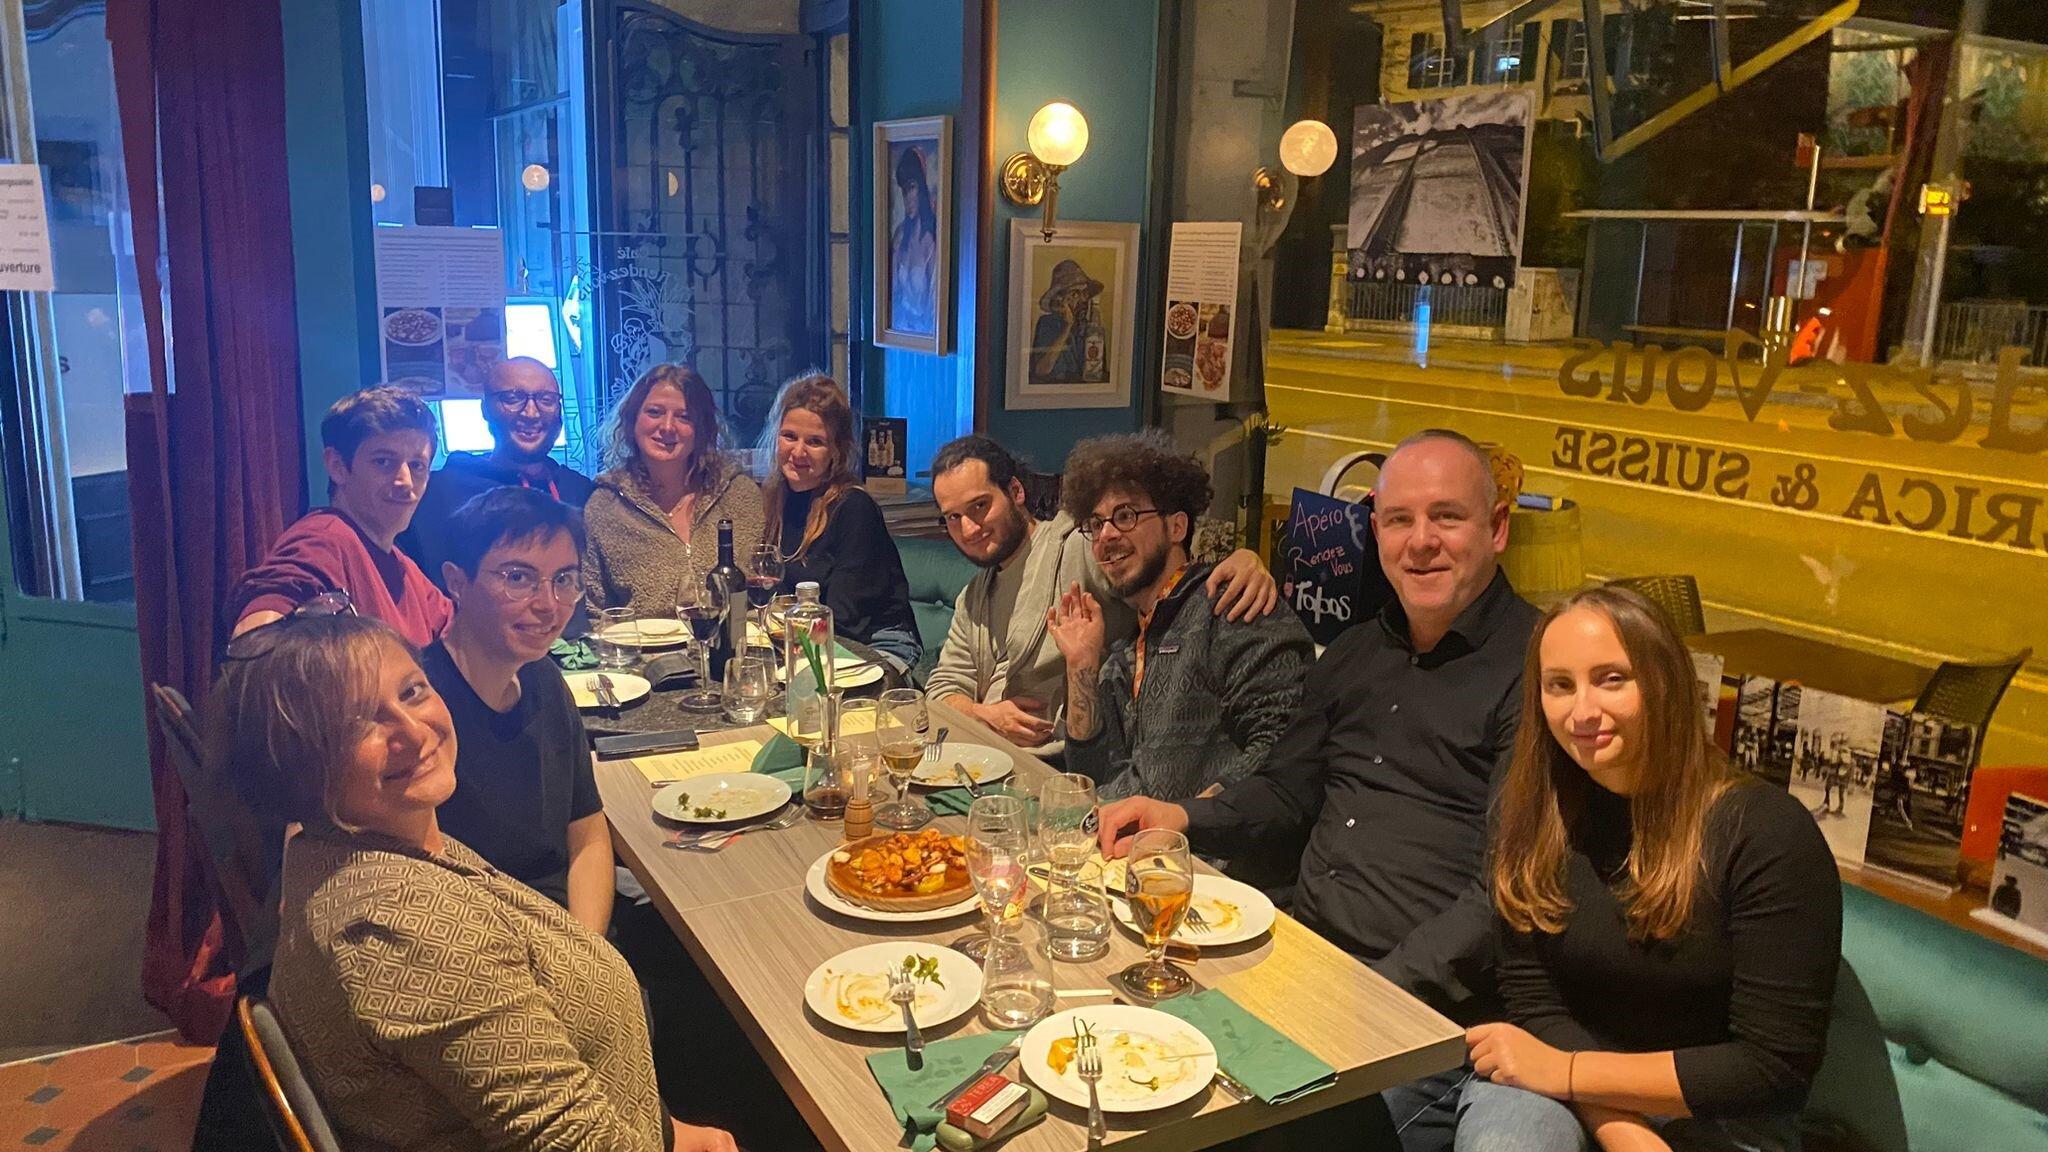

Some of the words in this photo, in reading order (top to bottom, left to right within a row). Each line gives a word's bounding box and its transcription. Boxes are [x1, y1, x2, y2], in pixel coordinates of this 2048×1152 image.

[1292, 501, 1343, 548] Apéro
[1287, 546, 1346, 572] Rendez
[1330, 558, 1354, 577] Vous
